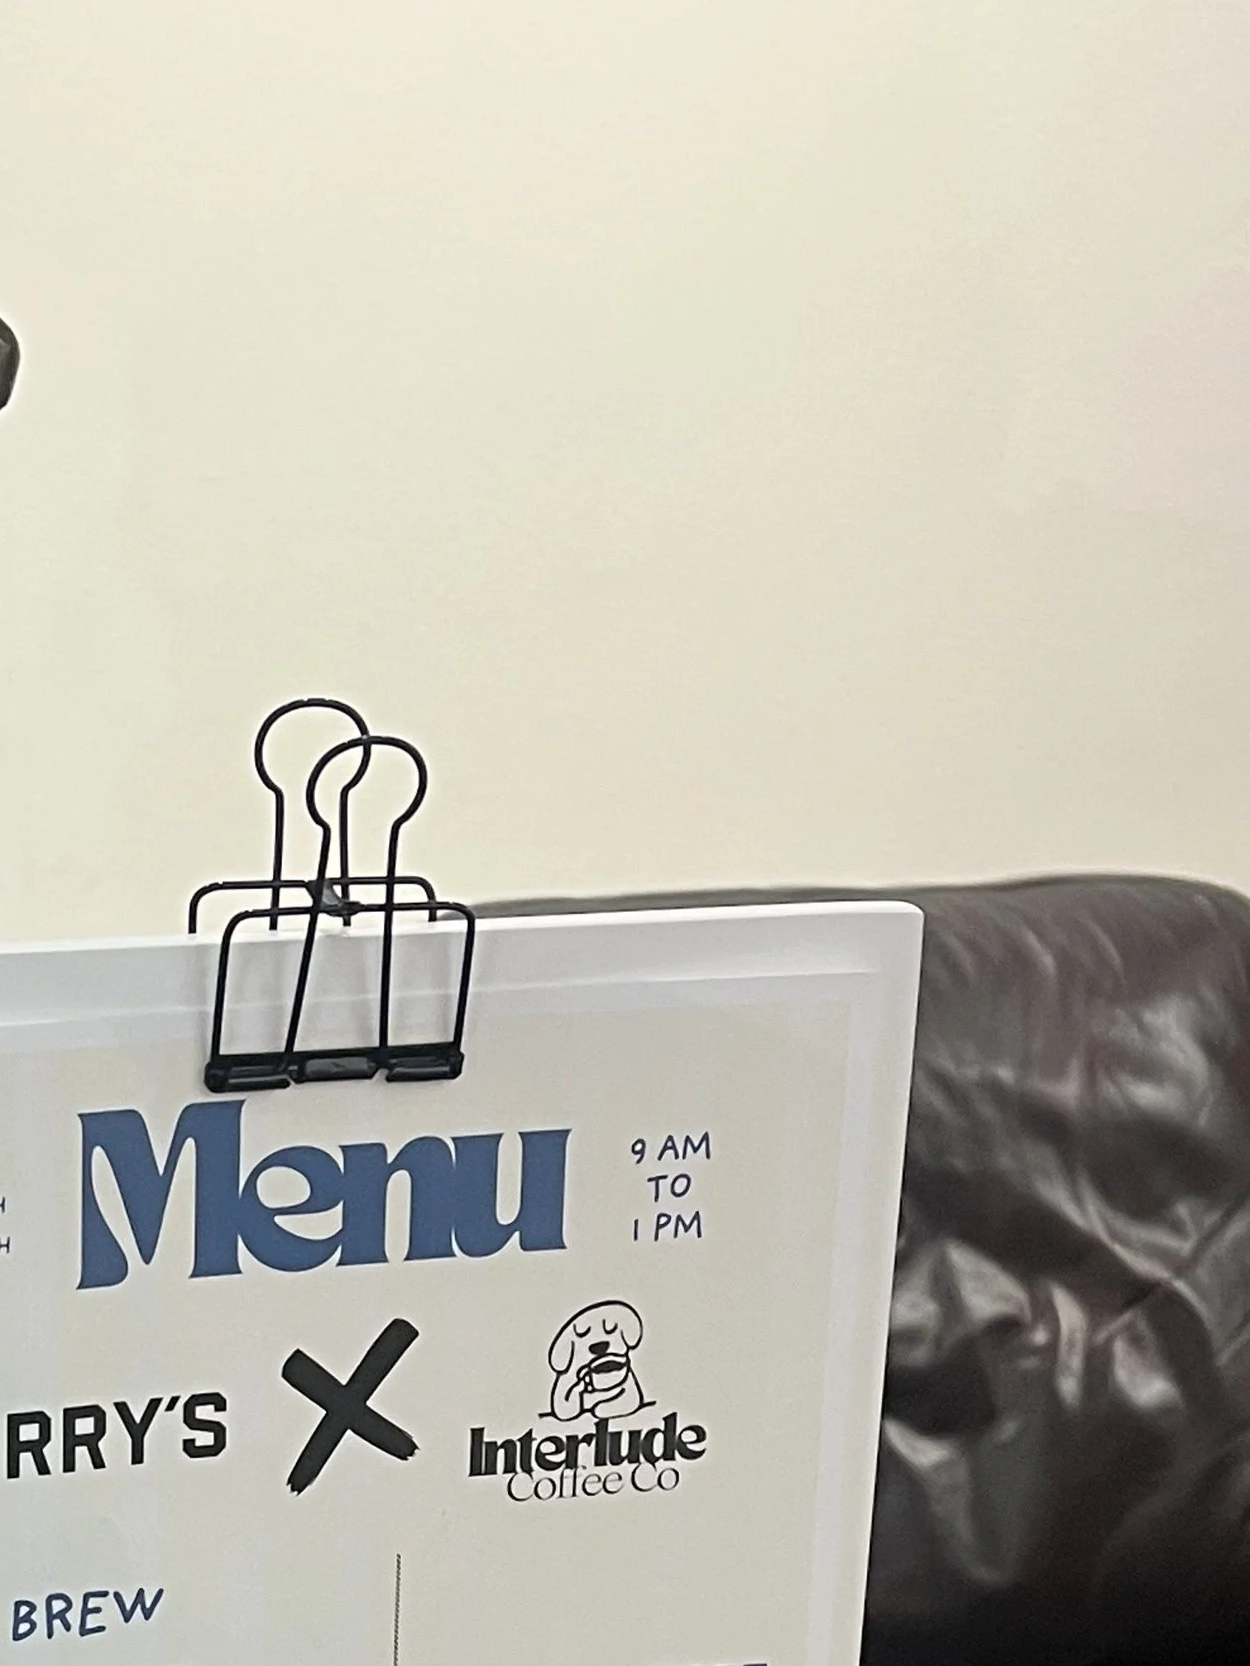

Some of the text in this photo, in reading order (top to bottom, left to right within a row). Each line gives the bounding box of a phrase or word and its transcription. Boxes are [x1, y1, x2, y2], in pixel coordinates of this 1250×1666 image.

[630, 1130, 712, 1165] 9 AM
[75, 1098, 573, 1291] Menu
[646, 1172, 692, 1204] TO
[653, 1210, 703, 1243] PM
[469, 1412, 707, 1477] Interlude
[507, 1462, 680, 1501] Coffee Co
[11, 1587, 165, 1642] BREW
